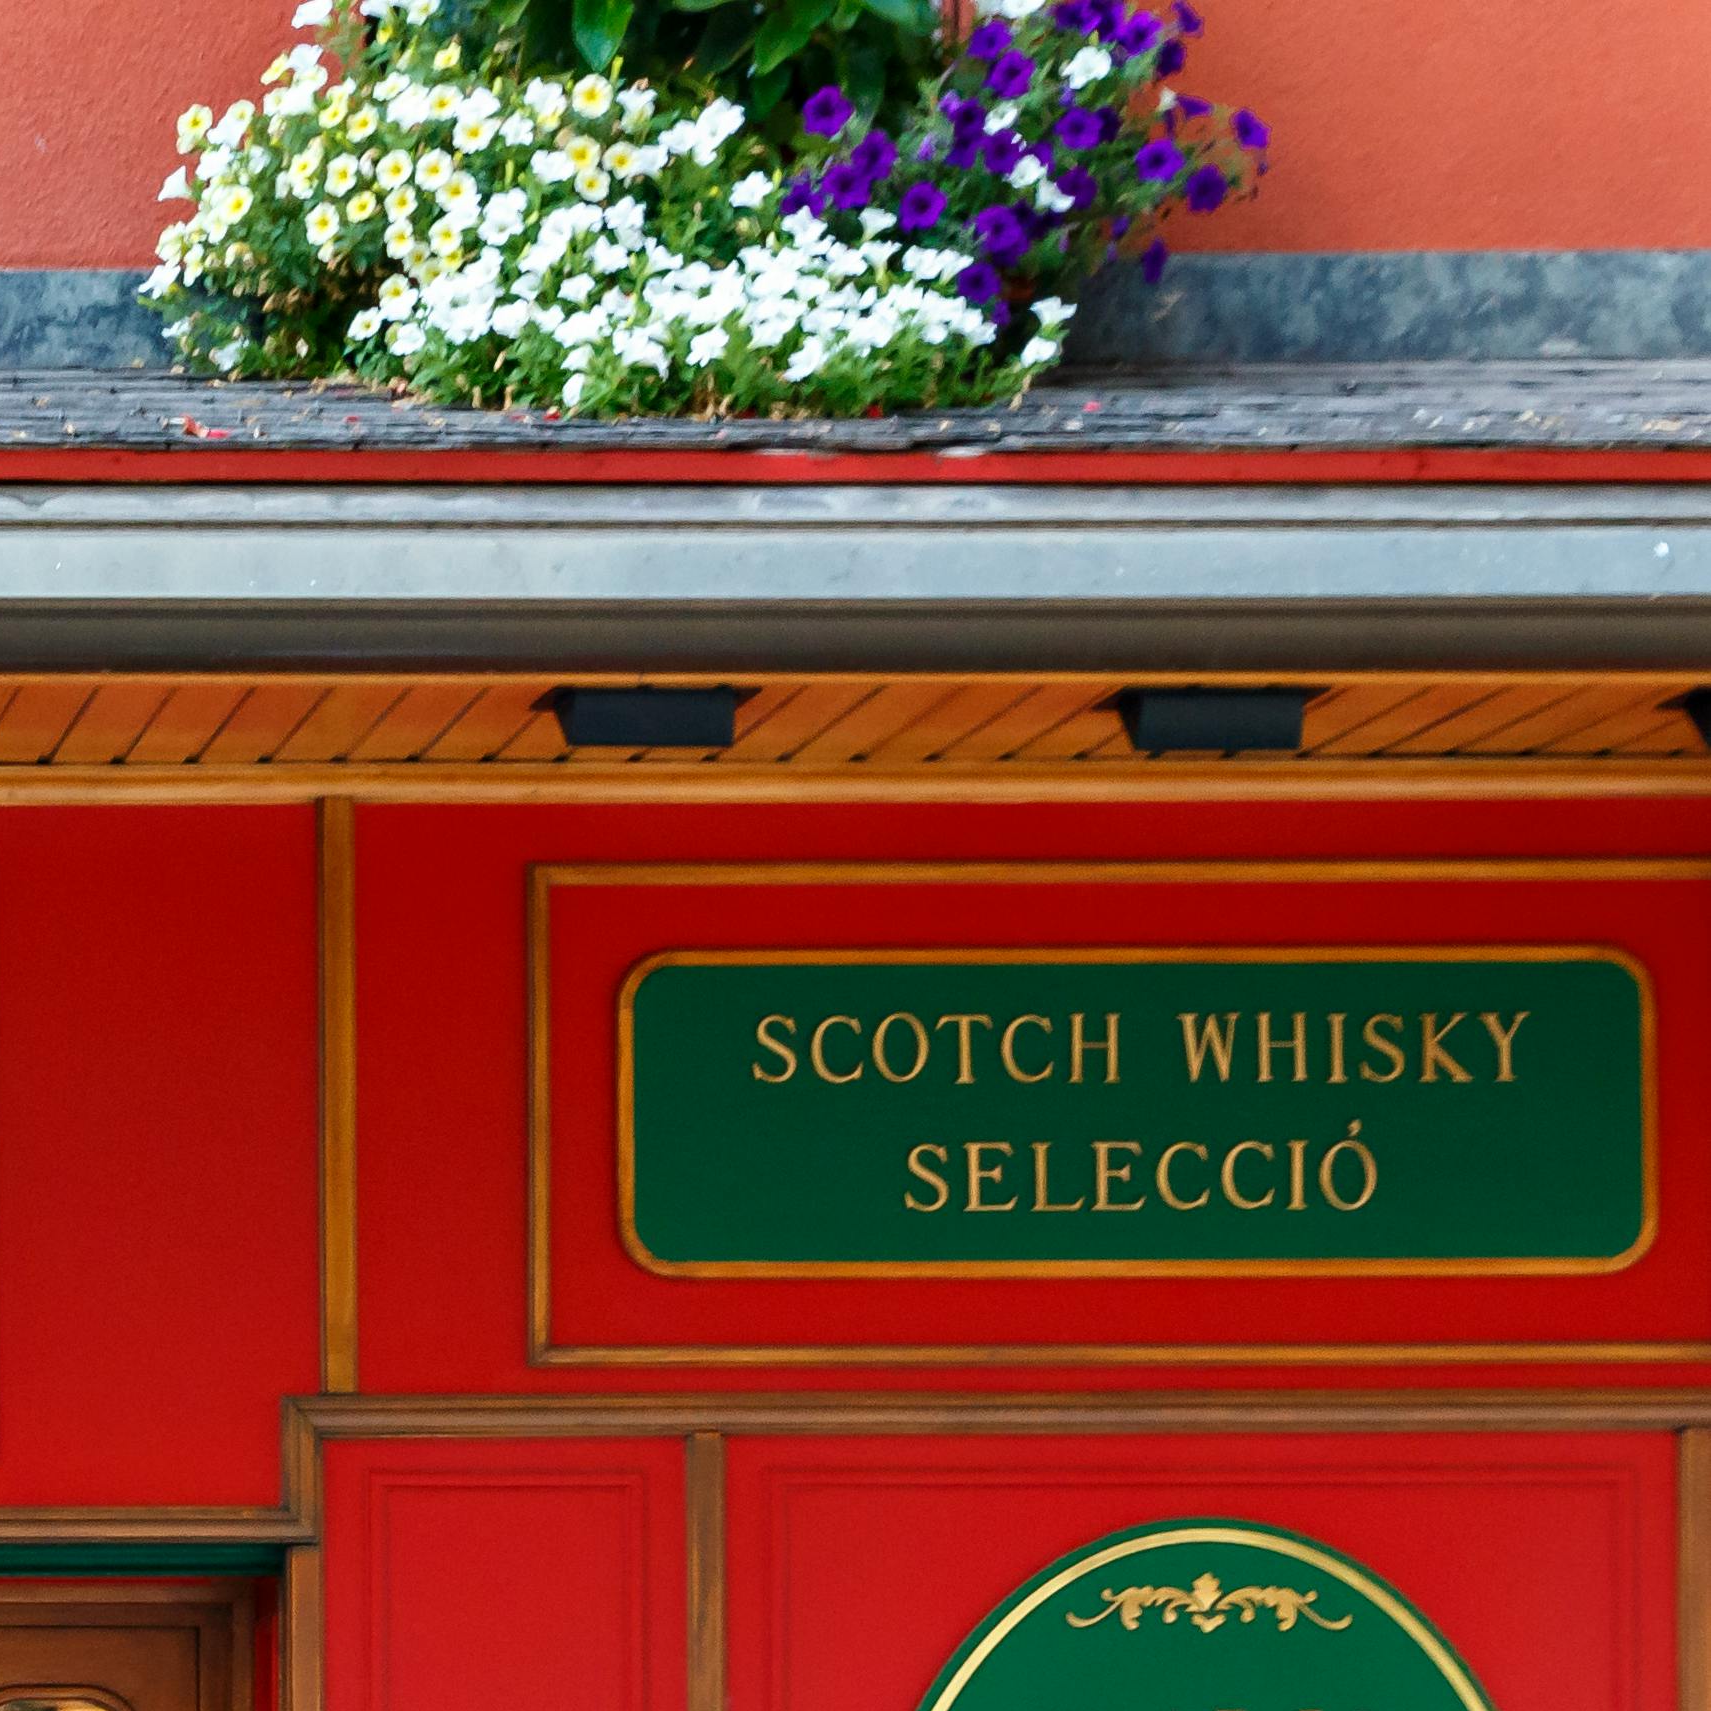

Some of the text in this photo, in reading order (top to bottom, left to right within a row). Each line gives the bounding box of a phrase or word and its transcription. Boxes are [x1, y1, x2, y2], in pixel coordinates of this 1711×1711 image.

[752, 1012, 1530, 1084] SCOTCH WHISKY
[904, 1120, 1378, 1212] SELECCIÓ
